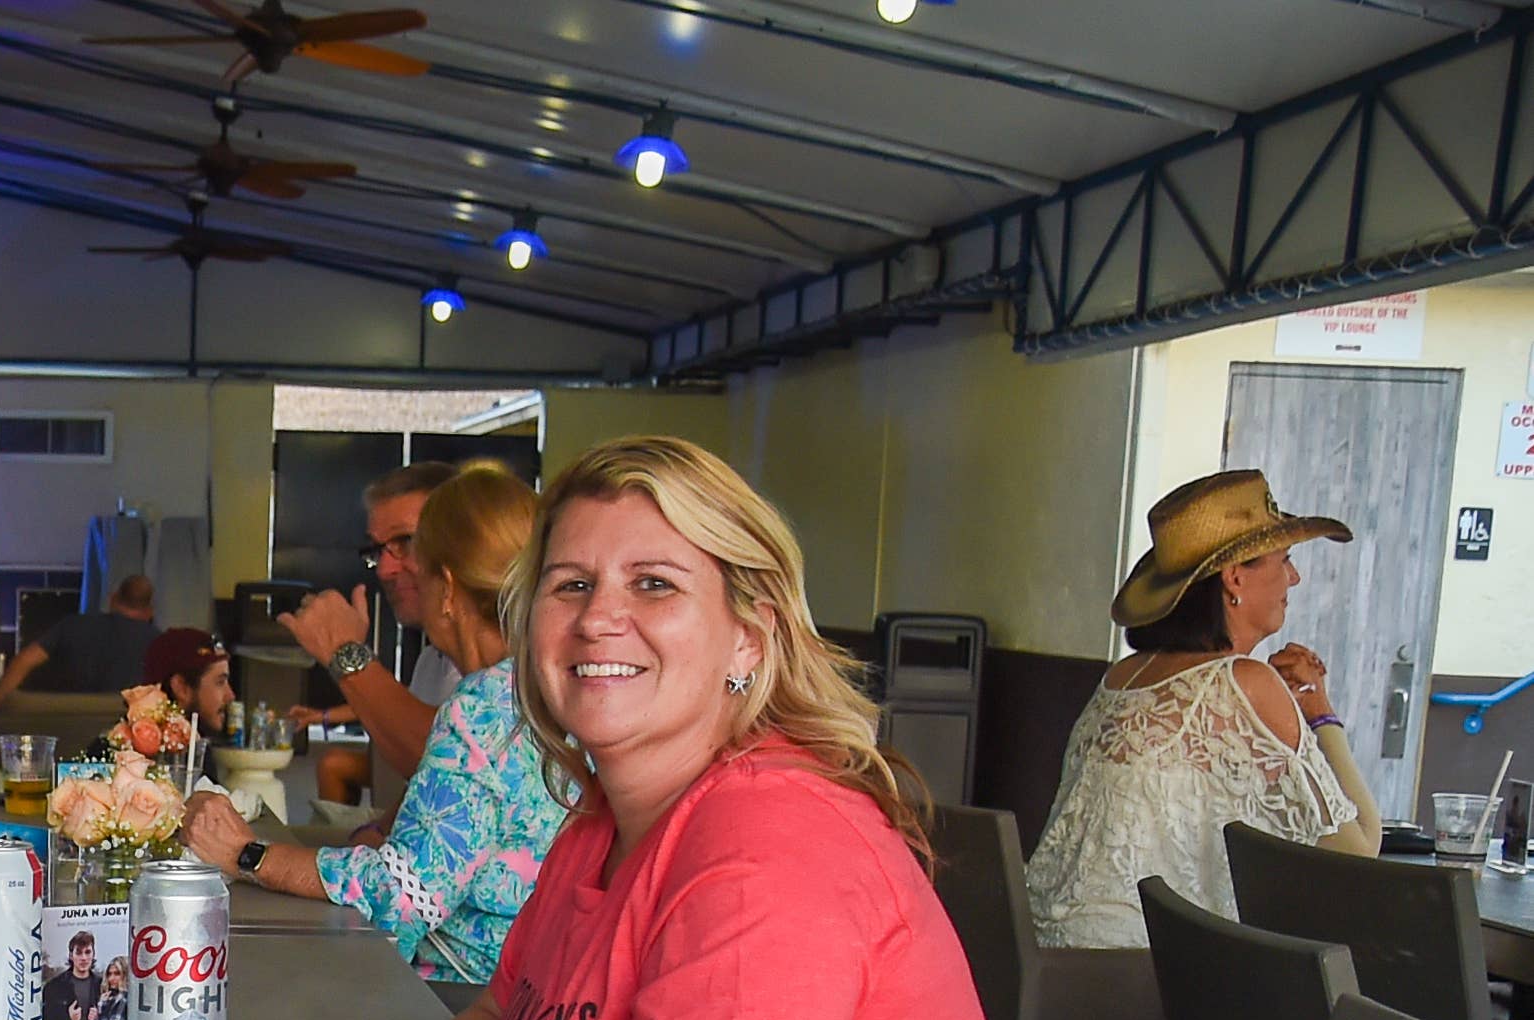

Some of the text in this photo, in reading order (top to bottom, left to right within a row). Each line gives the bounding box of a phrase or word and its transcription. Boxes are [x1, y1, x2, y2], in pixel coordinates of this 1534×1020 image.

[1378, 308, 1388, 318] OF
[1392, 308, 1409, 319] THE
[1324, 322, 1377, 334] VIP LOUNGE
[1511, 416, 1534, 427] OC
[1504, 464, 1534, 475] UPP
[61, 906, 128, 919] JUNA N JOEY
[137, 982, 228, 1014] LIGH
